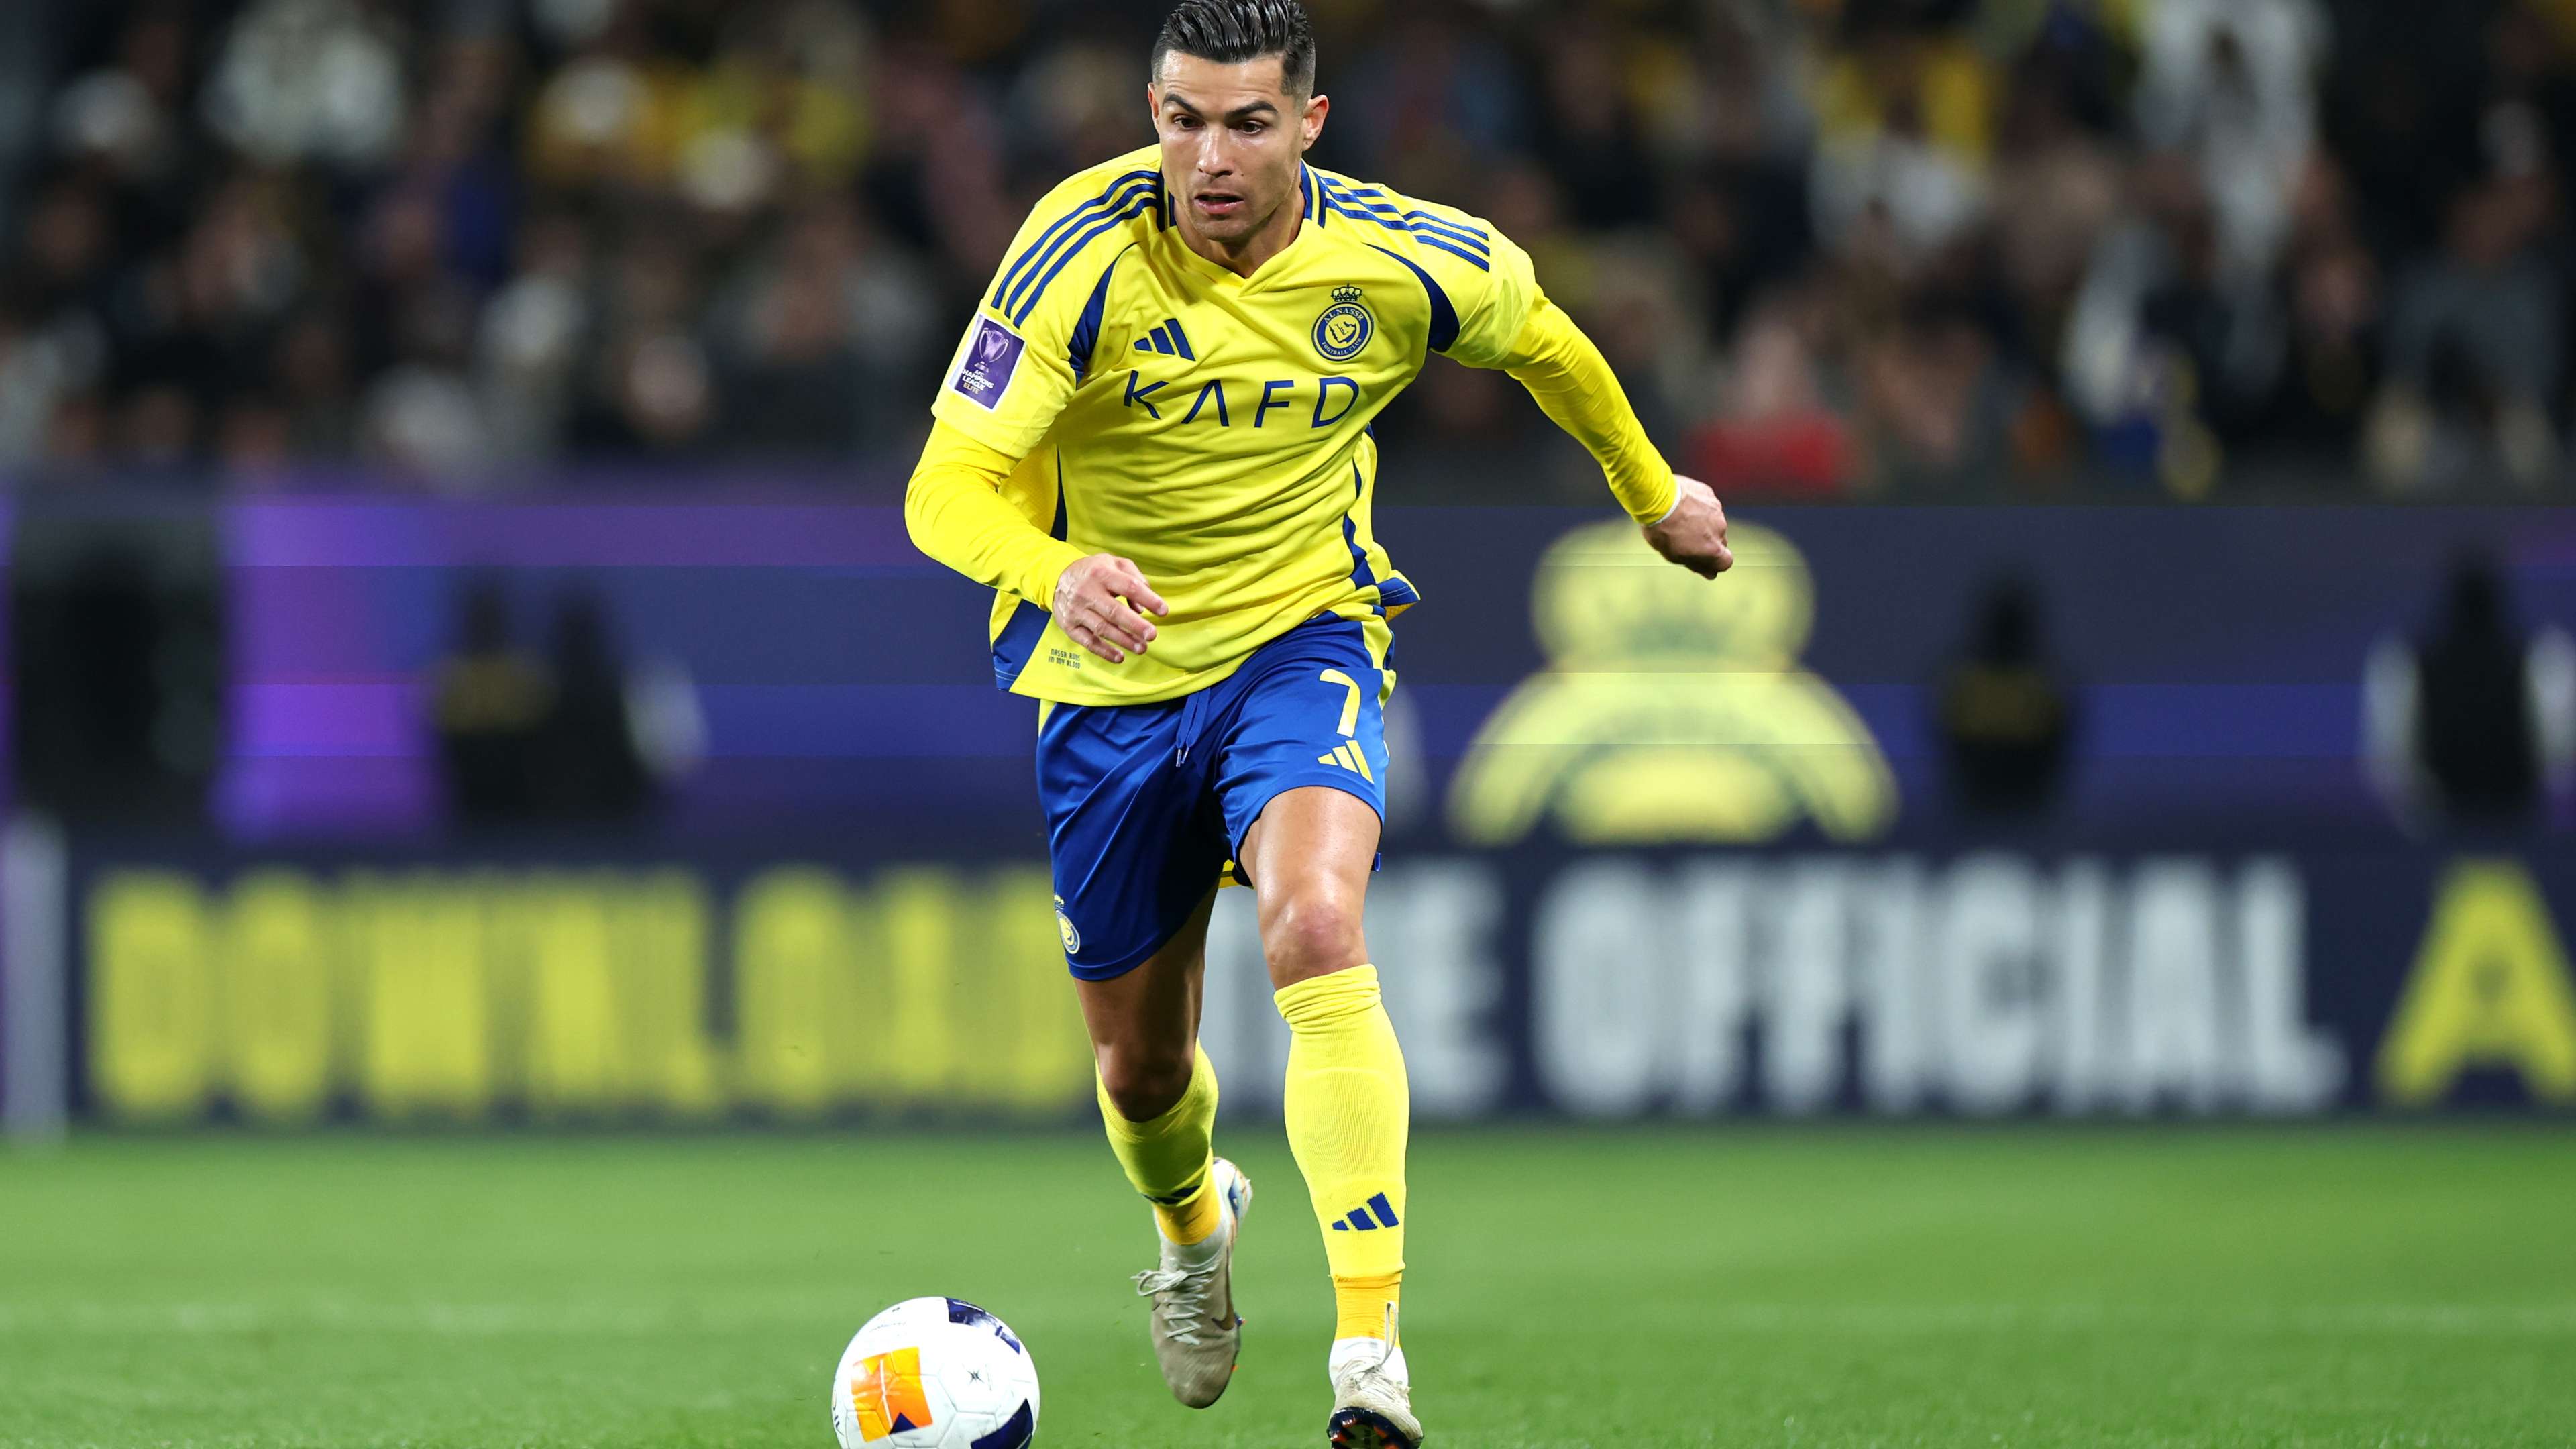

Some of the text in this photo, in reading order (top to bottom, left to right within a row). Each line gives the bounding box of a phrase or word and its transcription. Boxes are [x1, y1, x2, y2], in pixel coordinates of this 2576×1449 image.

[1336, 307, 1364, 321] NASSR
[1322, 337, 1362, 356] FOOTBALL CLUB
[974, 370, 985, 378] AFC
[962, 375, 986, 391] LEAGUE
[963, 382, 981, 394] ELITE
[1123, 369, 1360, 429] KAFD
[1319, 668, 1361, 738] 7
[1532, 857, 2341, 1112] OFFICIAL
